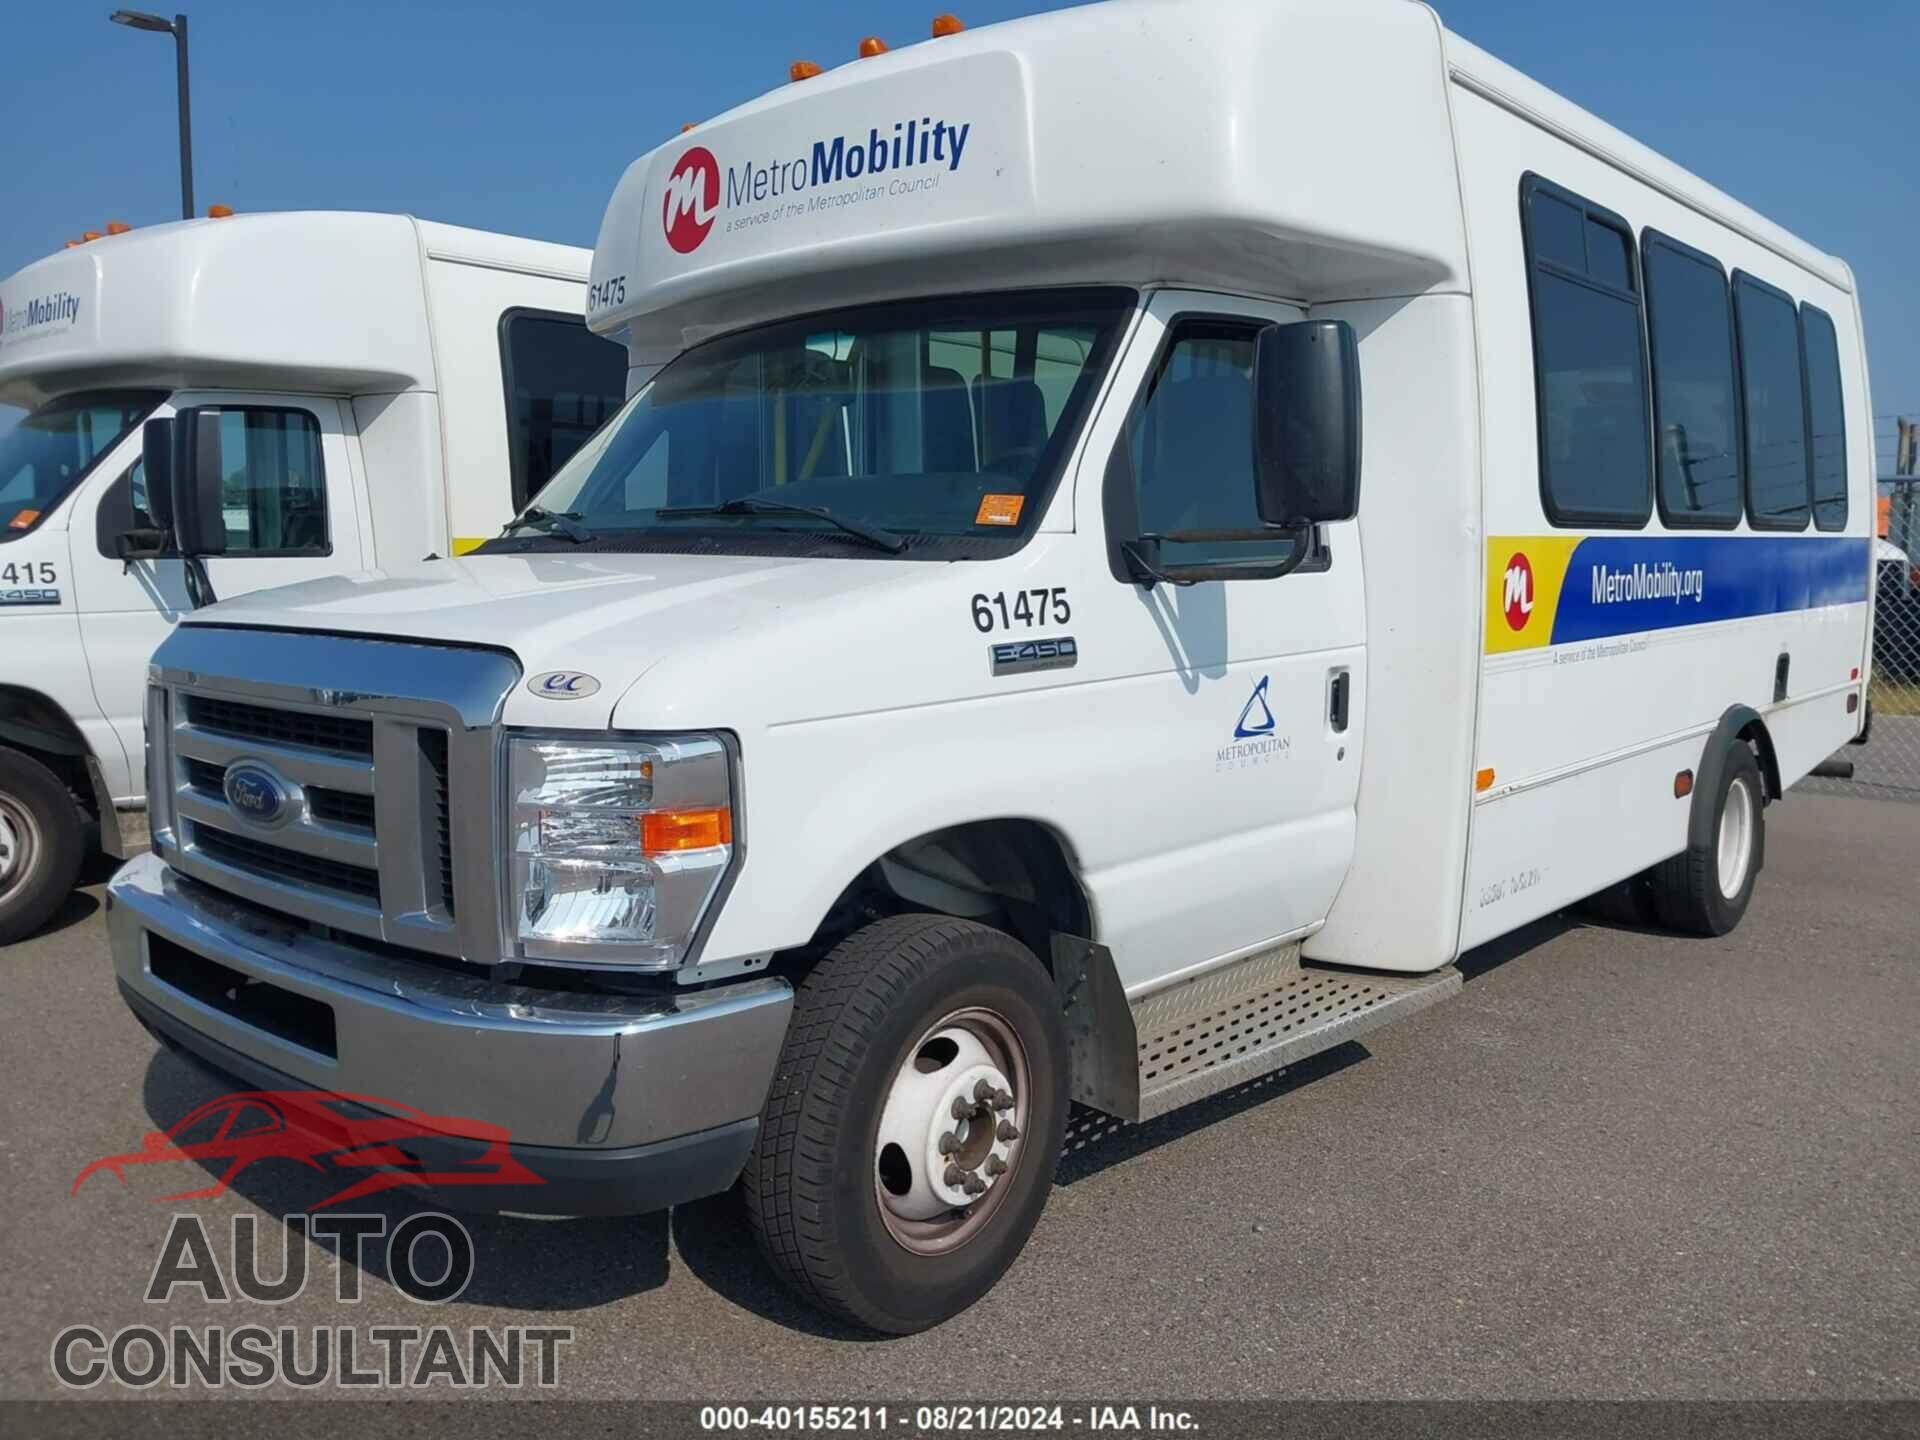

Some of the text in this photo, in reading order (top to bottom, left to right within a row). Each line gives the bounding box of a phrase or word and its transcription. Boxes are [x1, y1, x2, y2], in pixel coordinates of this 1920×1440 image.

[728, 117, 970, 209] MetroMobility
[726, 175, 940, 233] a service of the Metropolitan Council
[589, 275, 626, 312] 61475
[2, 562, 57, 584] 415
[1591, 562, 1703, 605] MetroMobility.org
[971, 587, 1071, 633] 61475
[1215, 736, 1291, 761] METROPOLITAN
[233, 777, 266, 810] Ford
